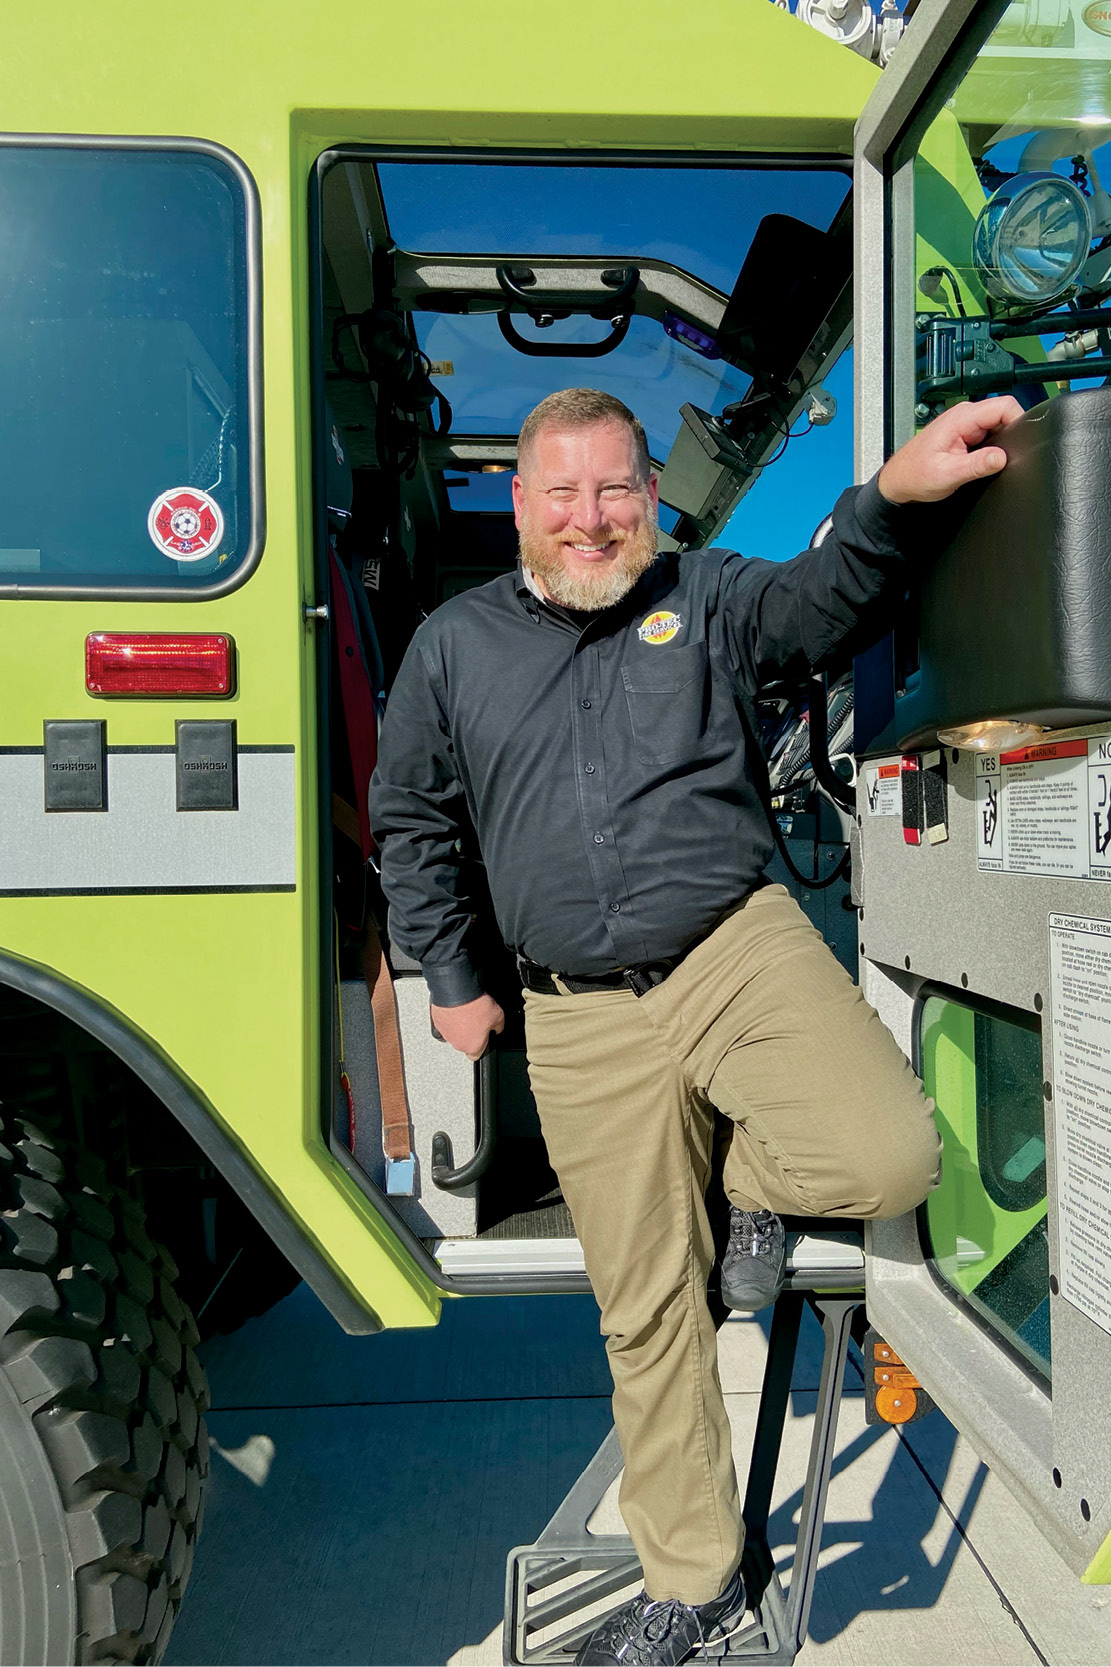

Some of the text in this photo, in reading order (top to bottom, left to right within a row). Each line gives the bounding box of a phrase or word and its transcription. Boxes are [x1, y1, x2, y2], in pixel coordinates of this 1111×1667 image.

[1030, 746, 1057, 758] WARNING
[52, 763, 97, 771] OSHKOSH
[184, 762, 228, 771] OSHKOSH
[981, 757, 996, 771] YES
[1054, 918, 1111, 934] DRY CHEMICAL SYSTEM
[1058, 931, 1075, 940] OPERATE
